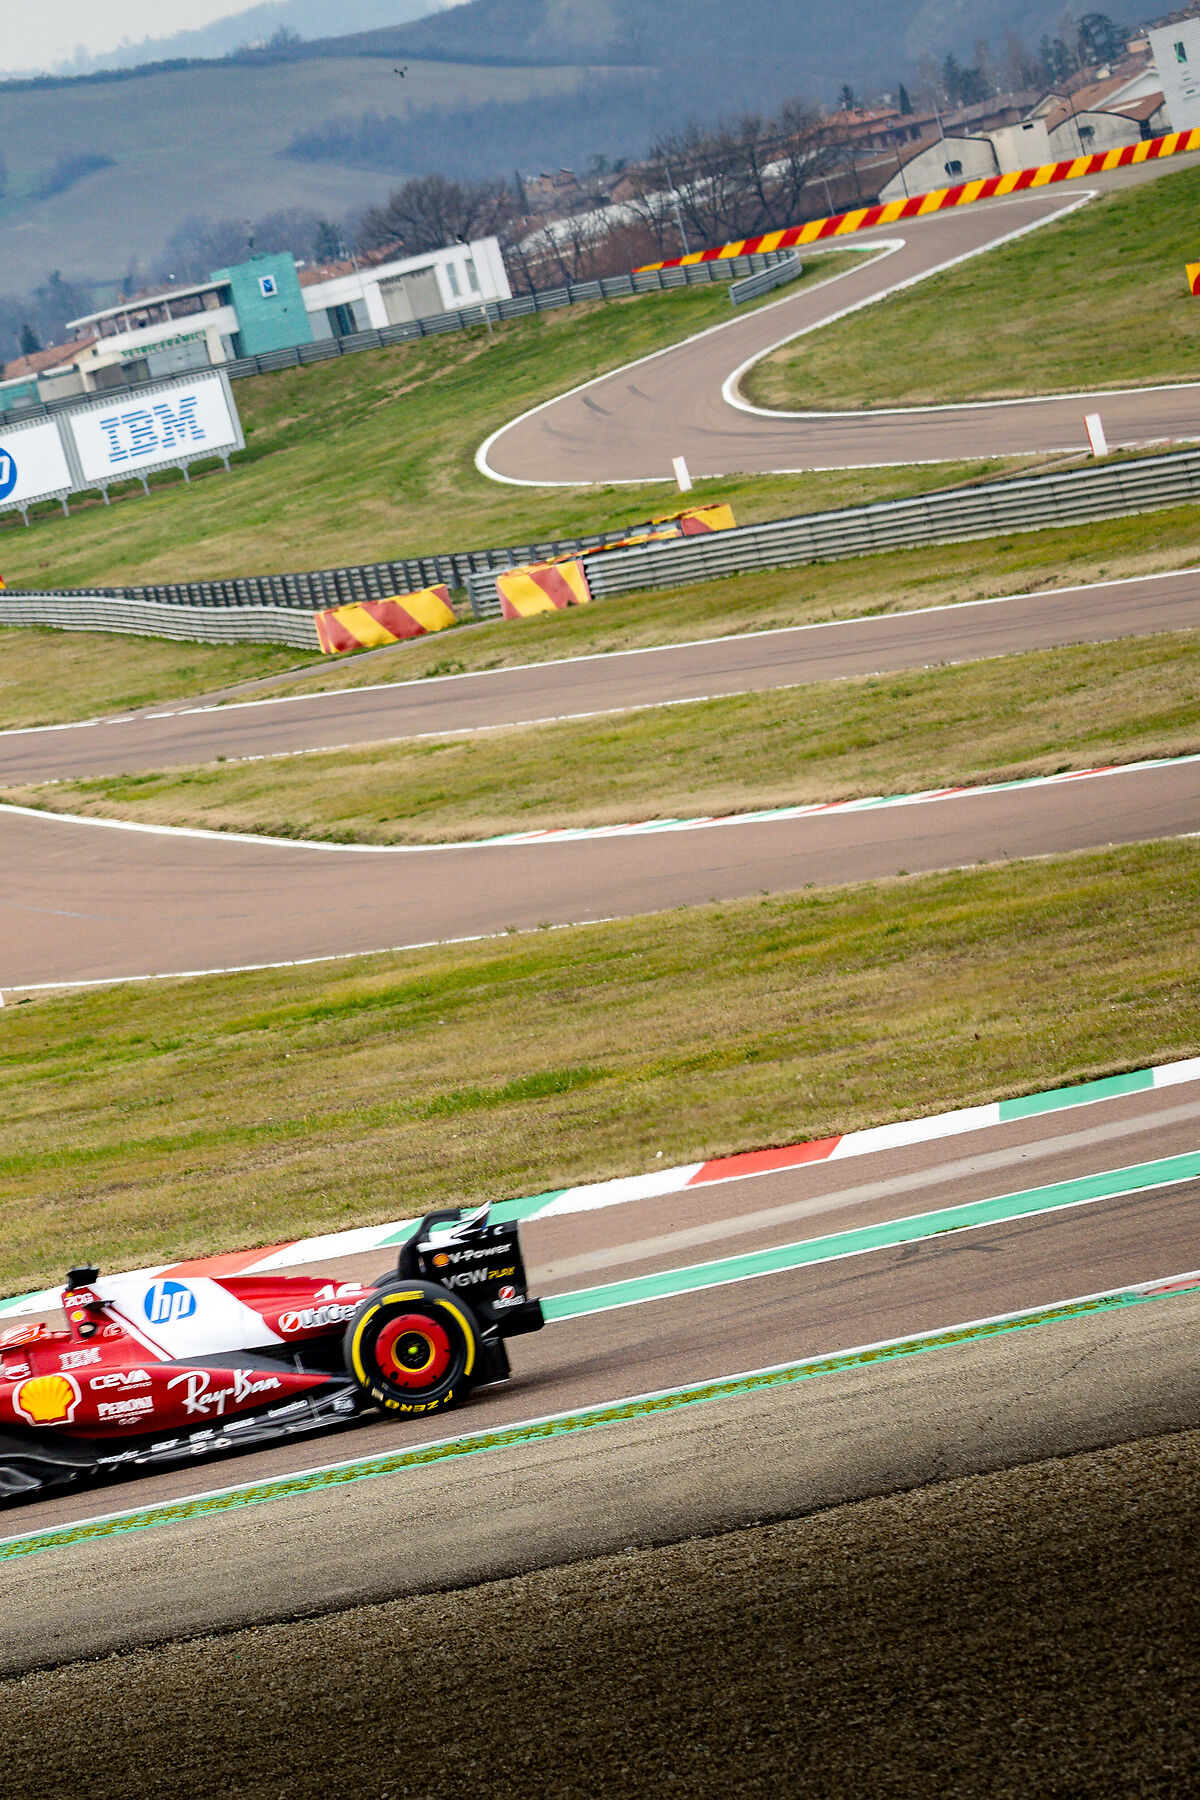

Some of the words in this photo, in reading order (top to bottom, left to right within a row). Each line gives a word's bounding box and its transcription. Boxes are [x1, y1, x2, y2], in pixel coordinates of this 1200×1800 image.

[100, 396, 206, 462] IBM
[449, 1243, 512, 1264] V-Power
[441, 1267, 489, 1289] VGW
[148, 1281, 194, 1324] hp
[59, 1347, 102, 1370] IBM
[167, 1369, 282, 1415] Ray-Ban
